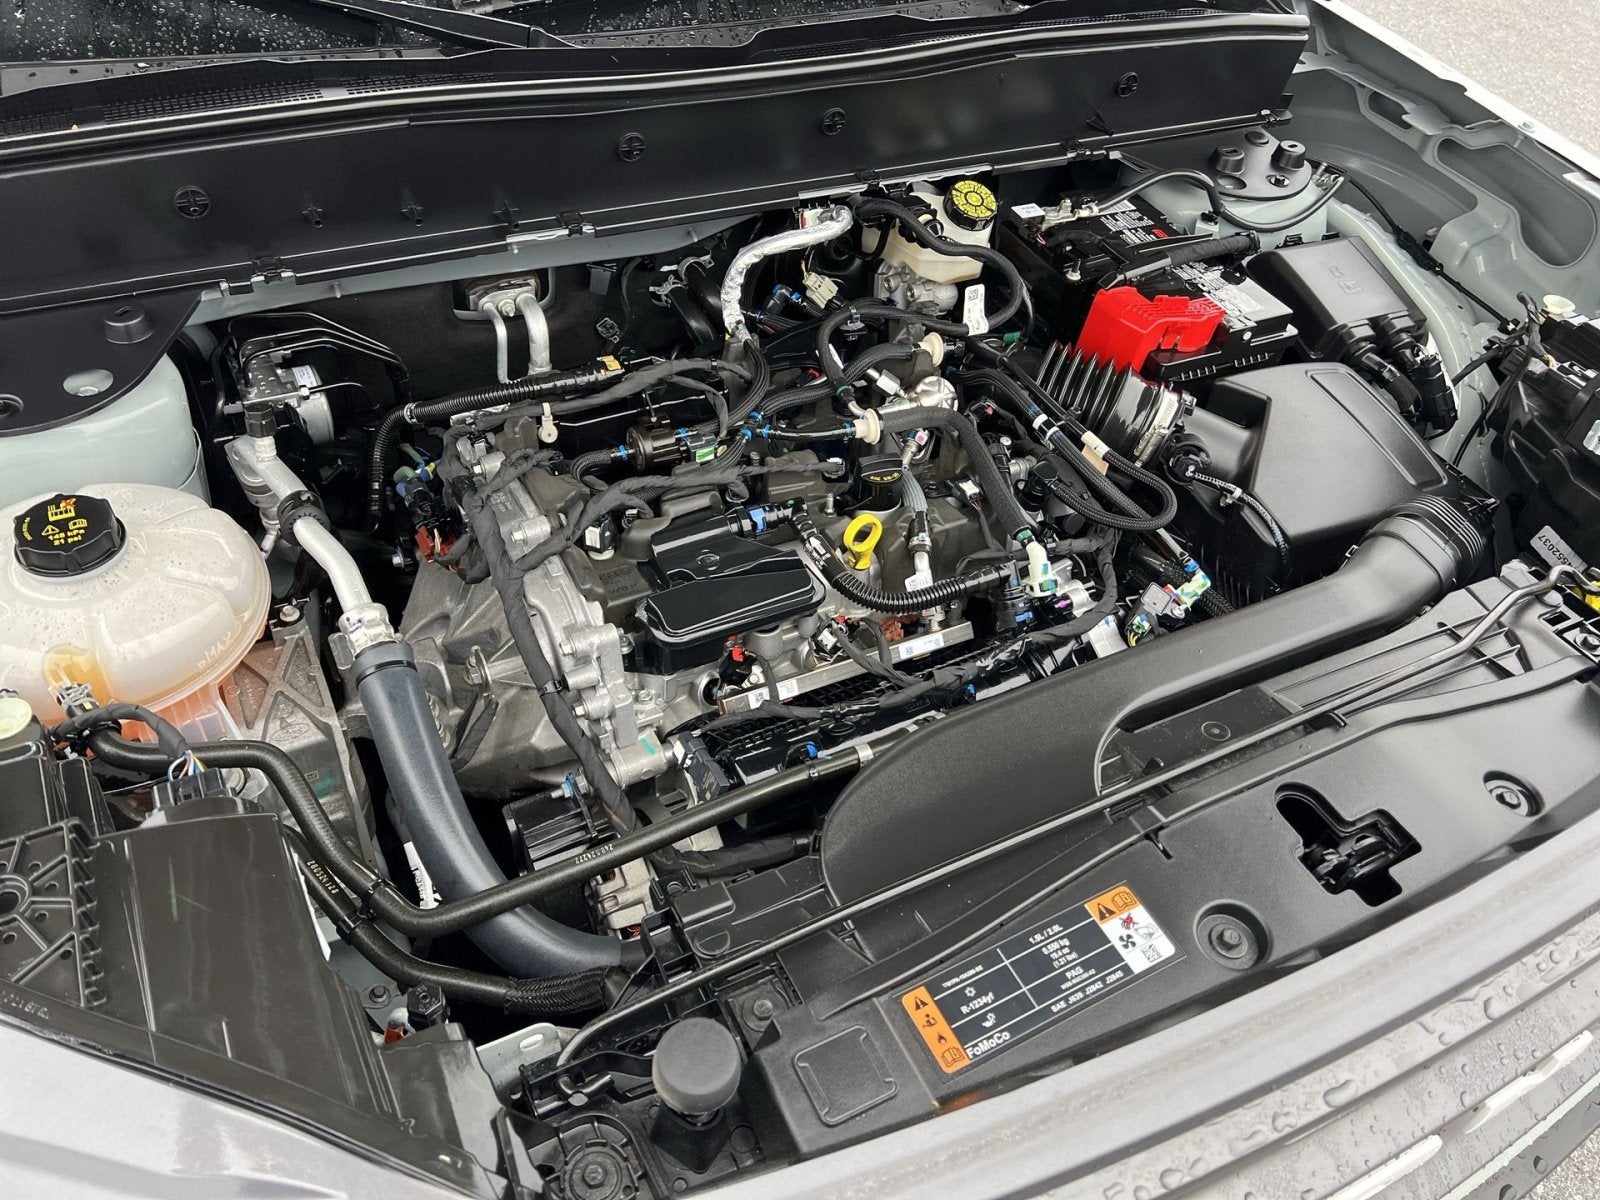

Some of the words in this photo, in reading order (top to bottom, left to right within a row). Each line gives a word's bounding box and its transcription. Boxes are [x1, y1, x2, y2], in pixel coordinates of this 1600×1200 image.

[1065, 966, 1083, 979] PAG
[960, 992, 995, 1014] R-1234yf
[1051, 1000, 1066, 1012] SAE
[965, 1030, 1011, 1059] FoMoCo
